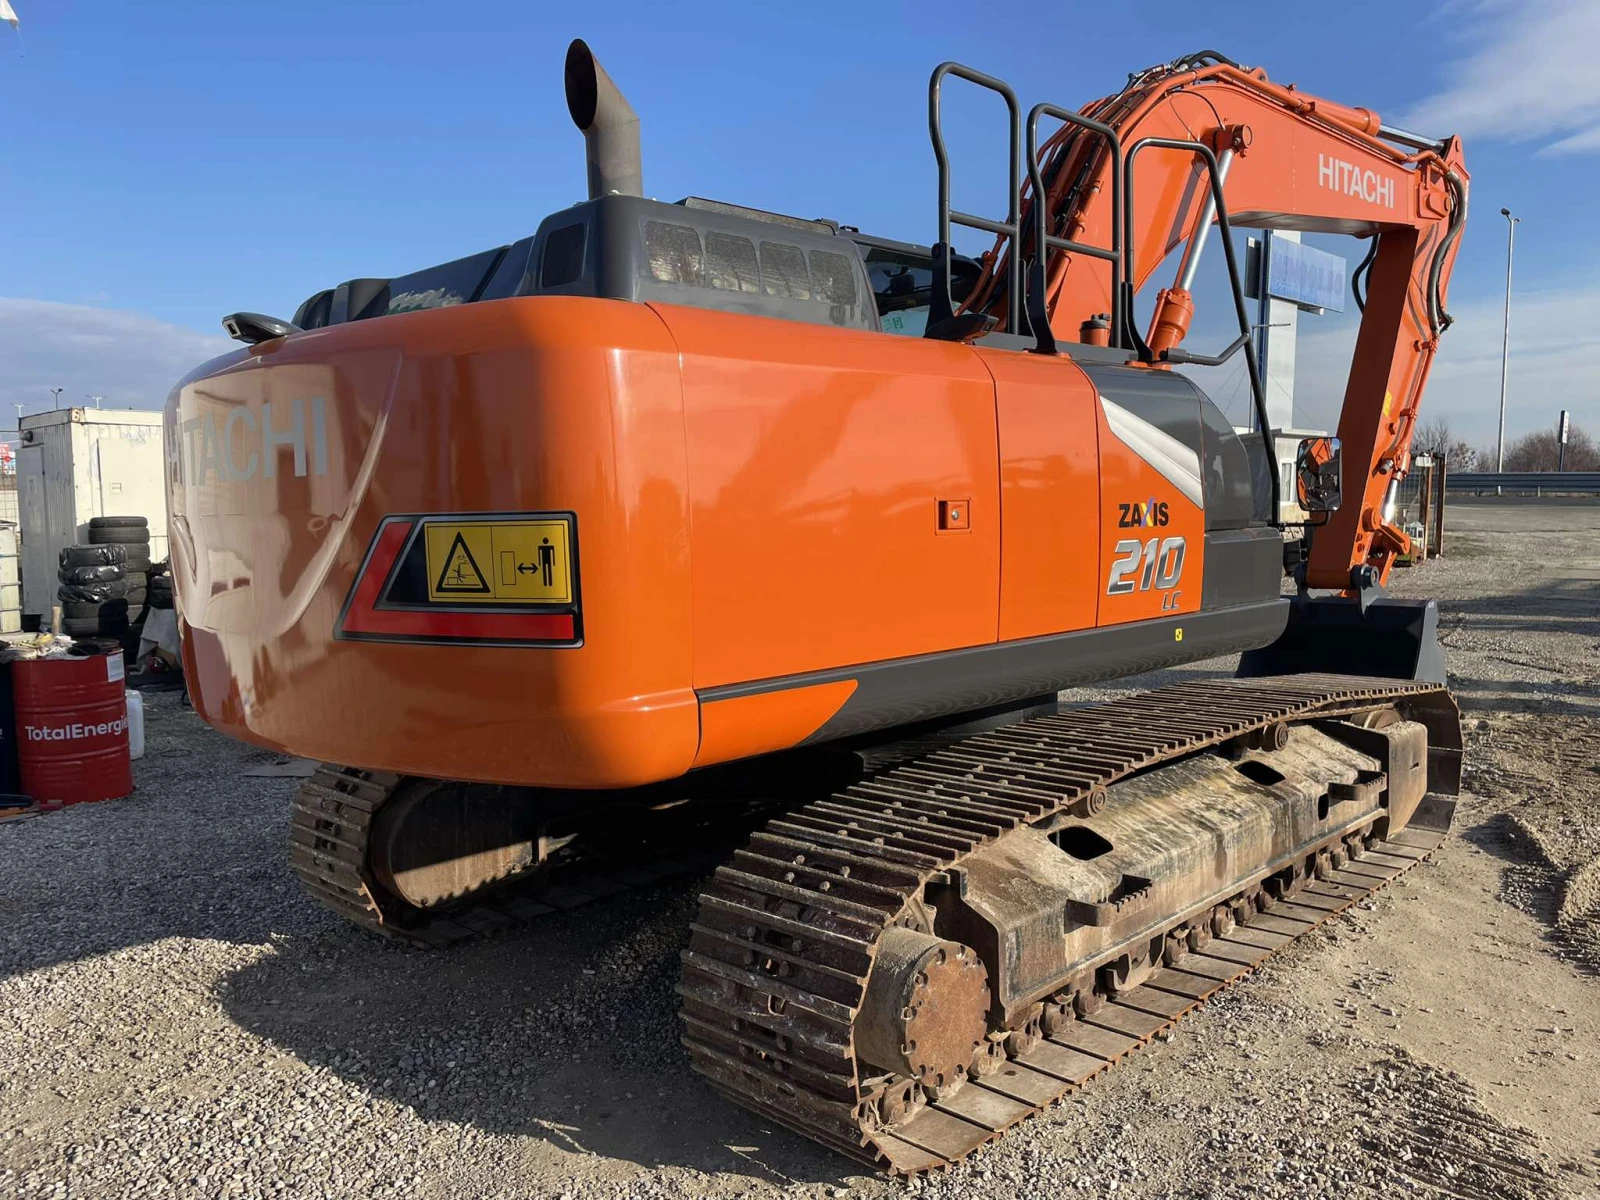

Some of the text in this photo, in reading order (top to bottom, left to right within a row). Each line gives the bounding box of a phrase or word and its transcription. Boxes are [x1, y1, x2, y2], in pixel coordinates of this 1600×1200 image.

[1319, 153, 1394, 209] HITACHI
[1119, 497, 1168, 528] ZAXIS
[1108, 537, 1186, 595] 210
[1162, 592, 1181, 610] LC
